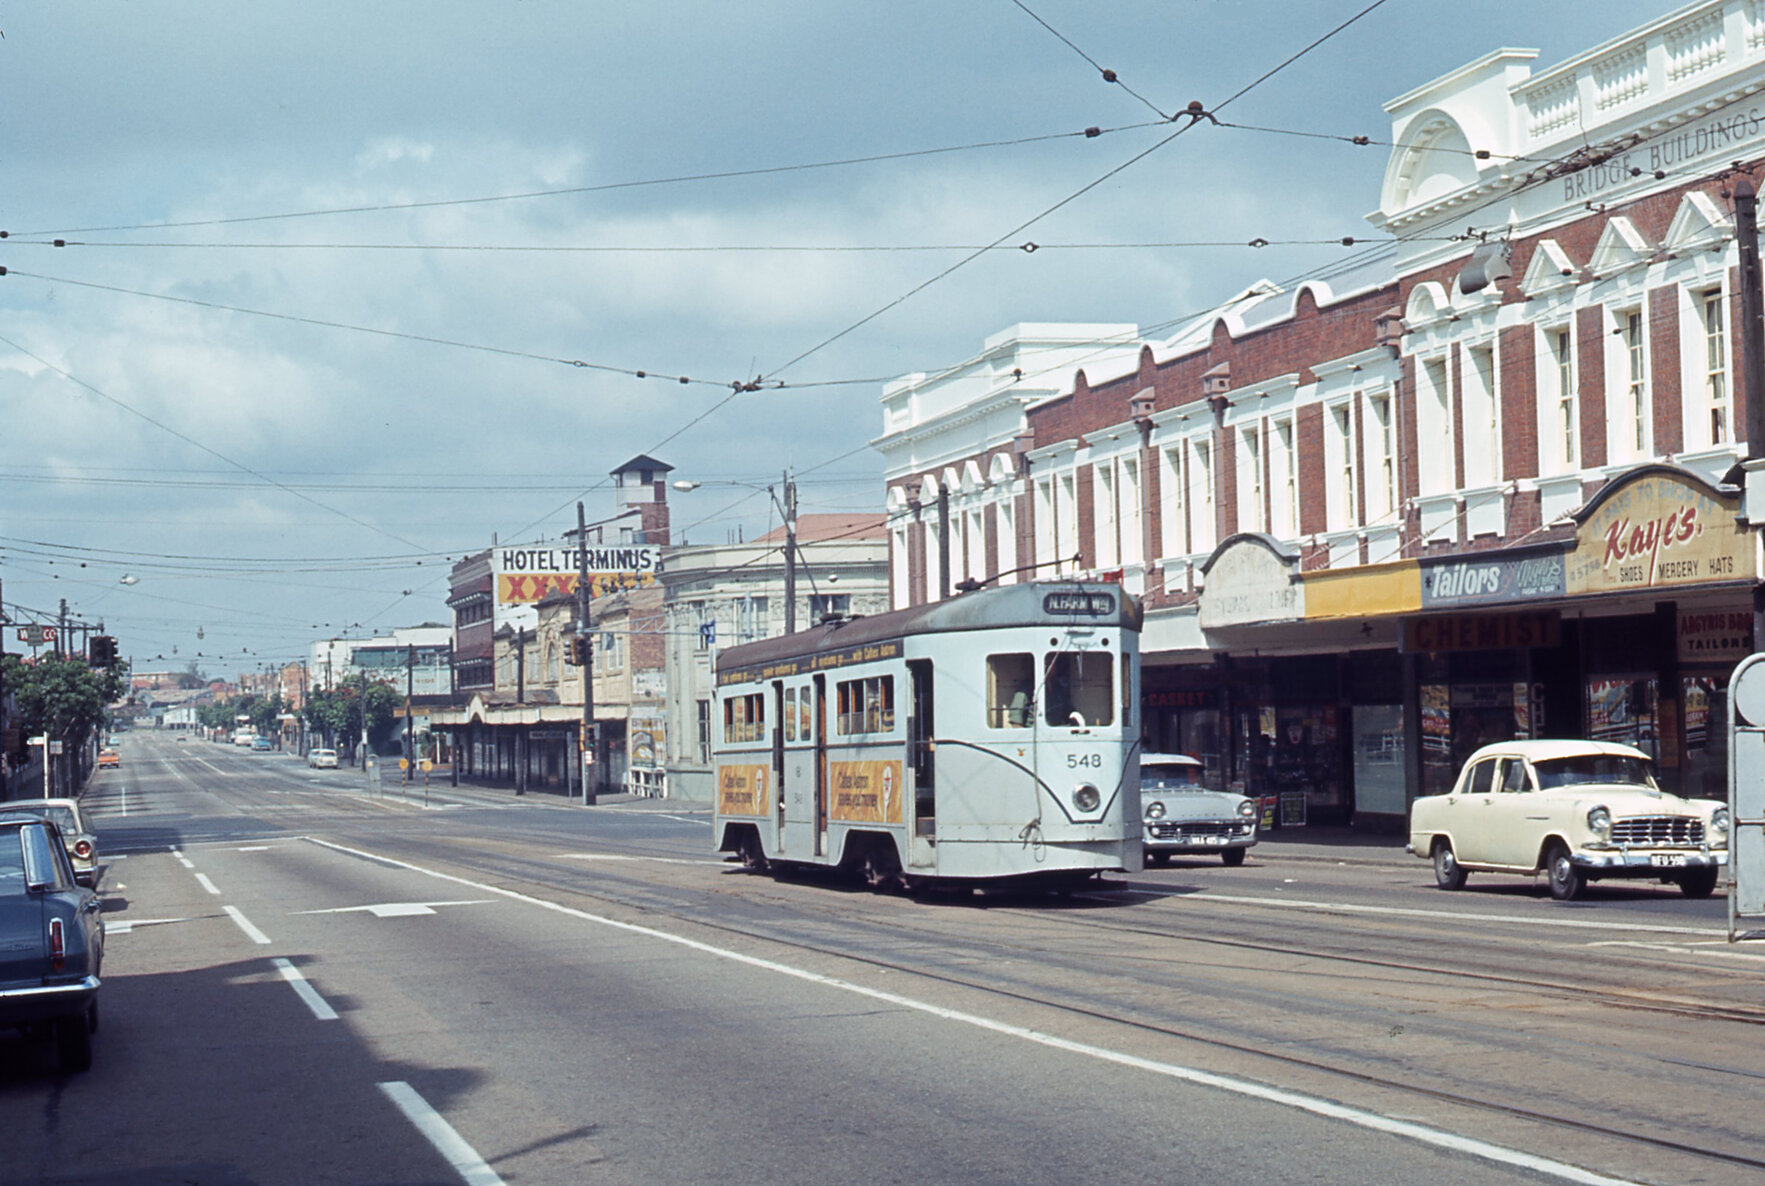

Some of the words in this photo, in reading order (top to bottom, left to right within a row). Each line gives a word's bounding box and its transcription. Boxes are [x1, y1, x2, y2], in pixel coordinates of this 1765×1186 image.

[1564, 153, 1632, 201] BRIDGE
[1650, 108, 1760, 171] BUILDINGS
[1637, 483, 1652, 500] TO
[503, 550, 558, 571] HOTEL
[562, 549, 652, 570] TERMINUS
[1620, 565, 1643, 583] SHOES
[1659, 560, 1698, 579] MERCERY
[1709, 556, 1733, 574] HATS
[1432, 562, 1500, 598] Tailors
[1415, 613, 1550, 649] CHEMIST
[1067, 754, 1101, 768] 548
